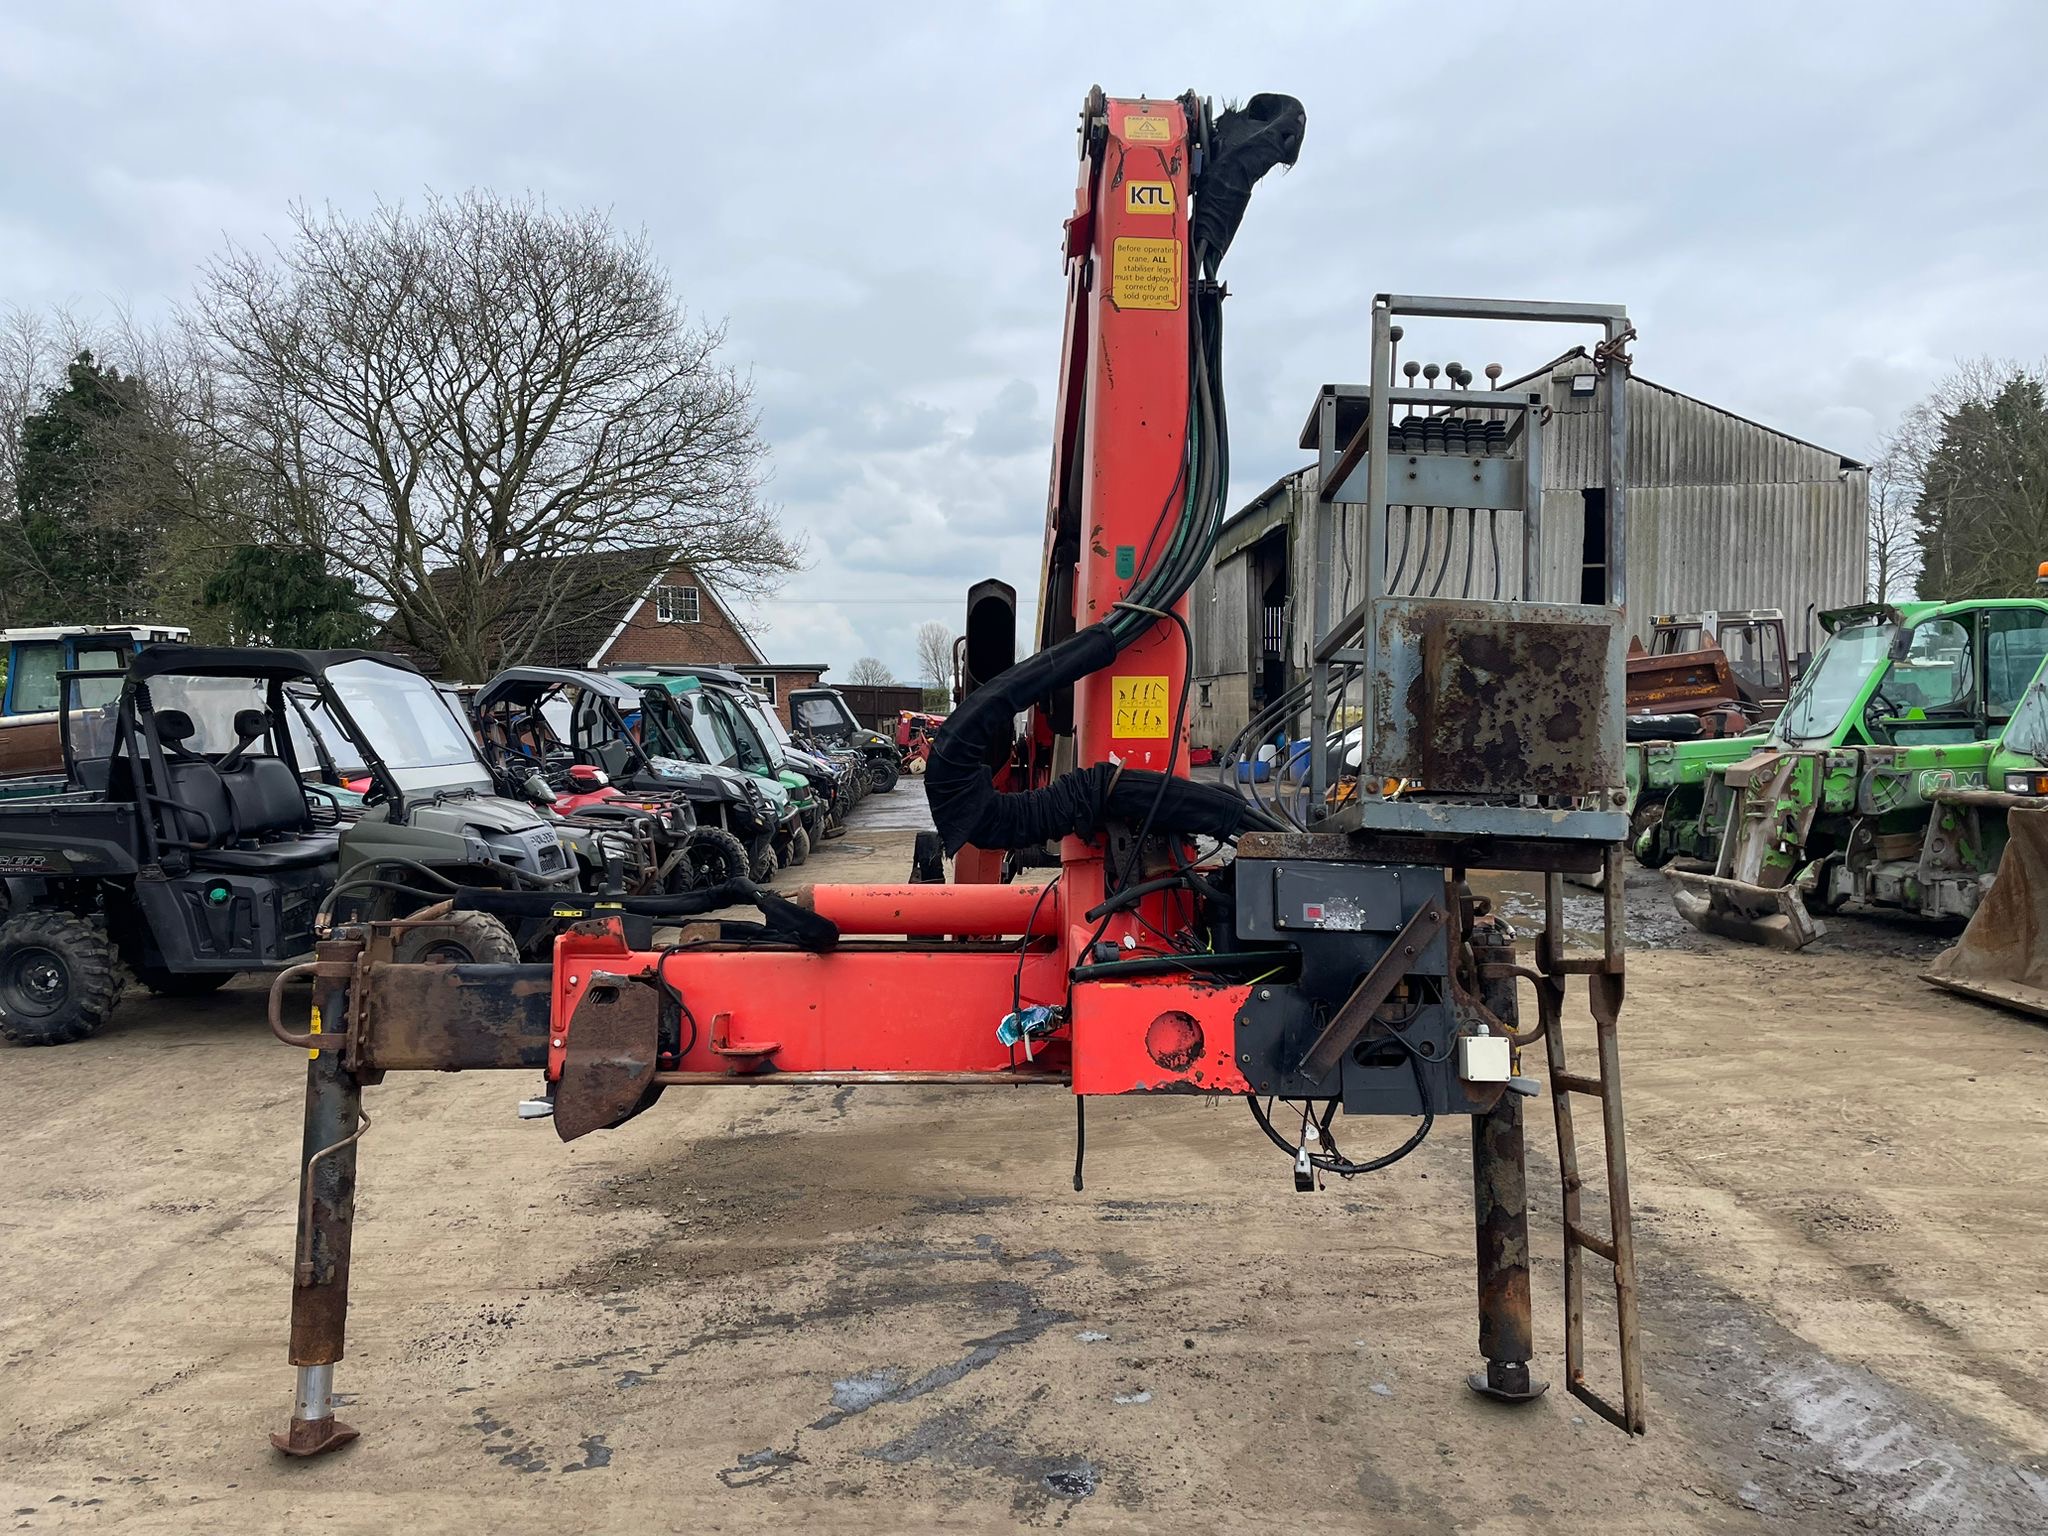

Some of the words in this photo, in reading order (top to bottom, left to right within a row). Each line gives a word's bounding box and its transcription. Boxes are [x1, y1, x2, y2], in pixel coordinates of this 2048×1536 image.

[1131, 186, 1170, 205] KTL
[1117, 244, 1141, 252] Before
[1123, 265, 1154, 273] stabiliser
[1125, 284, 1156, 292] correctly
